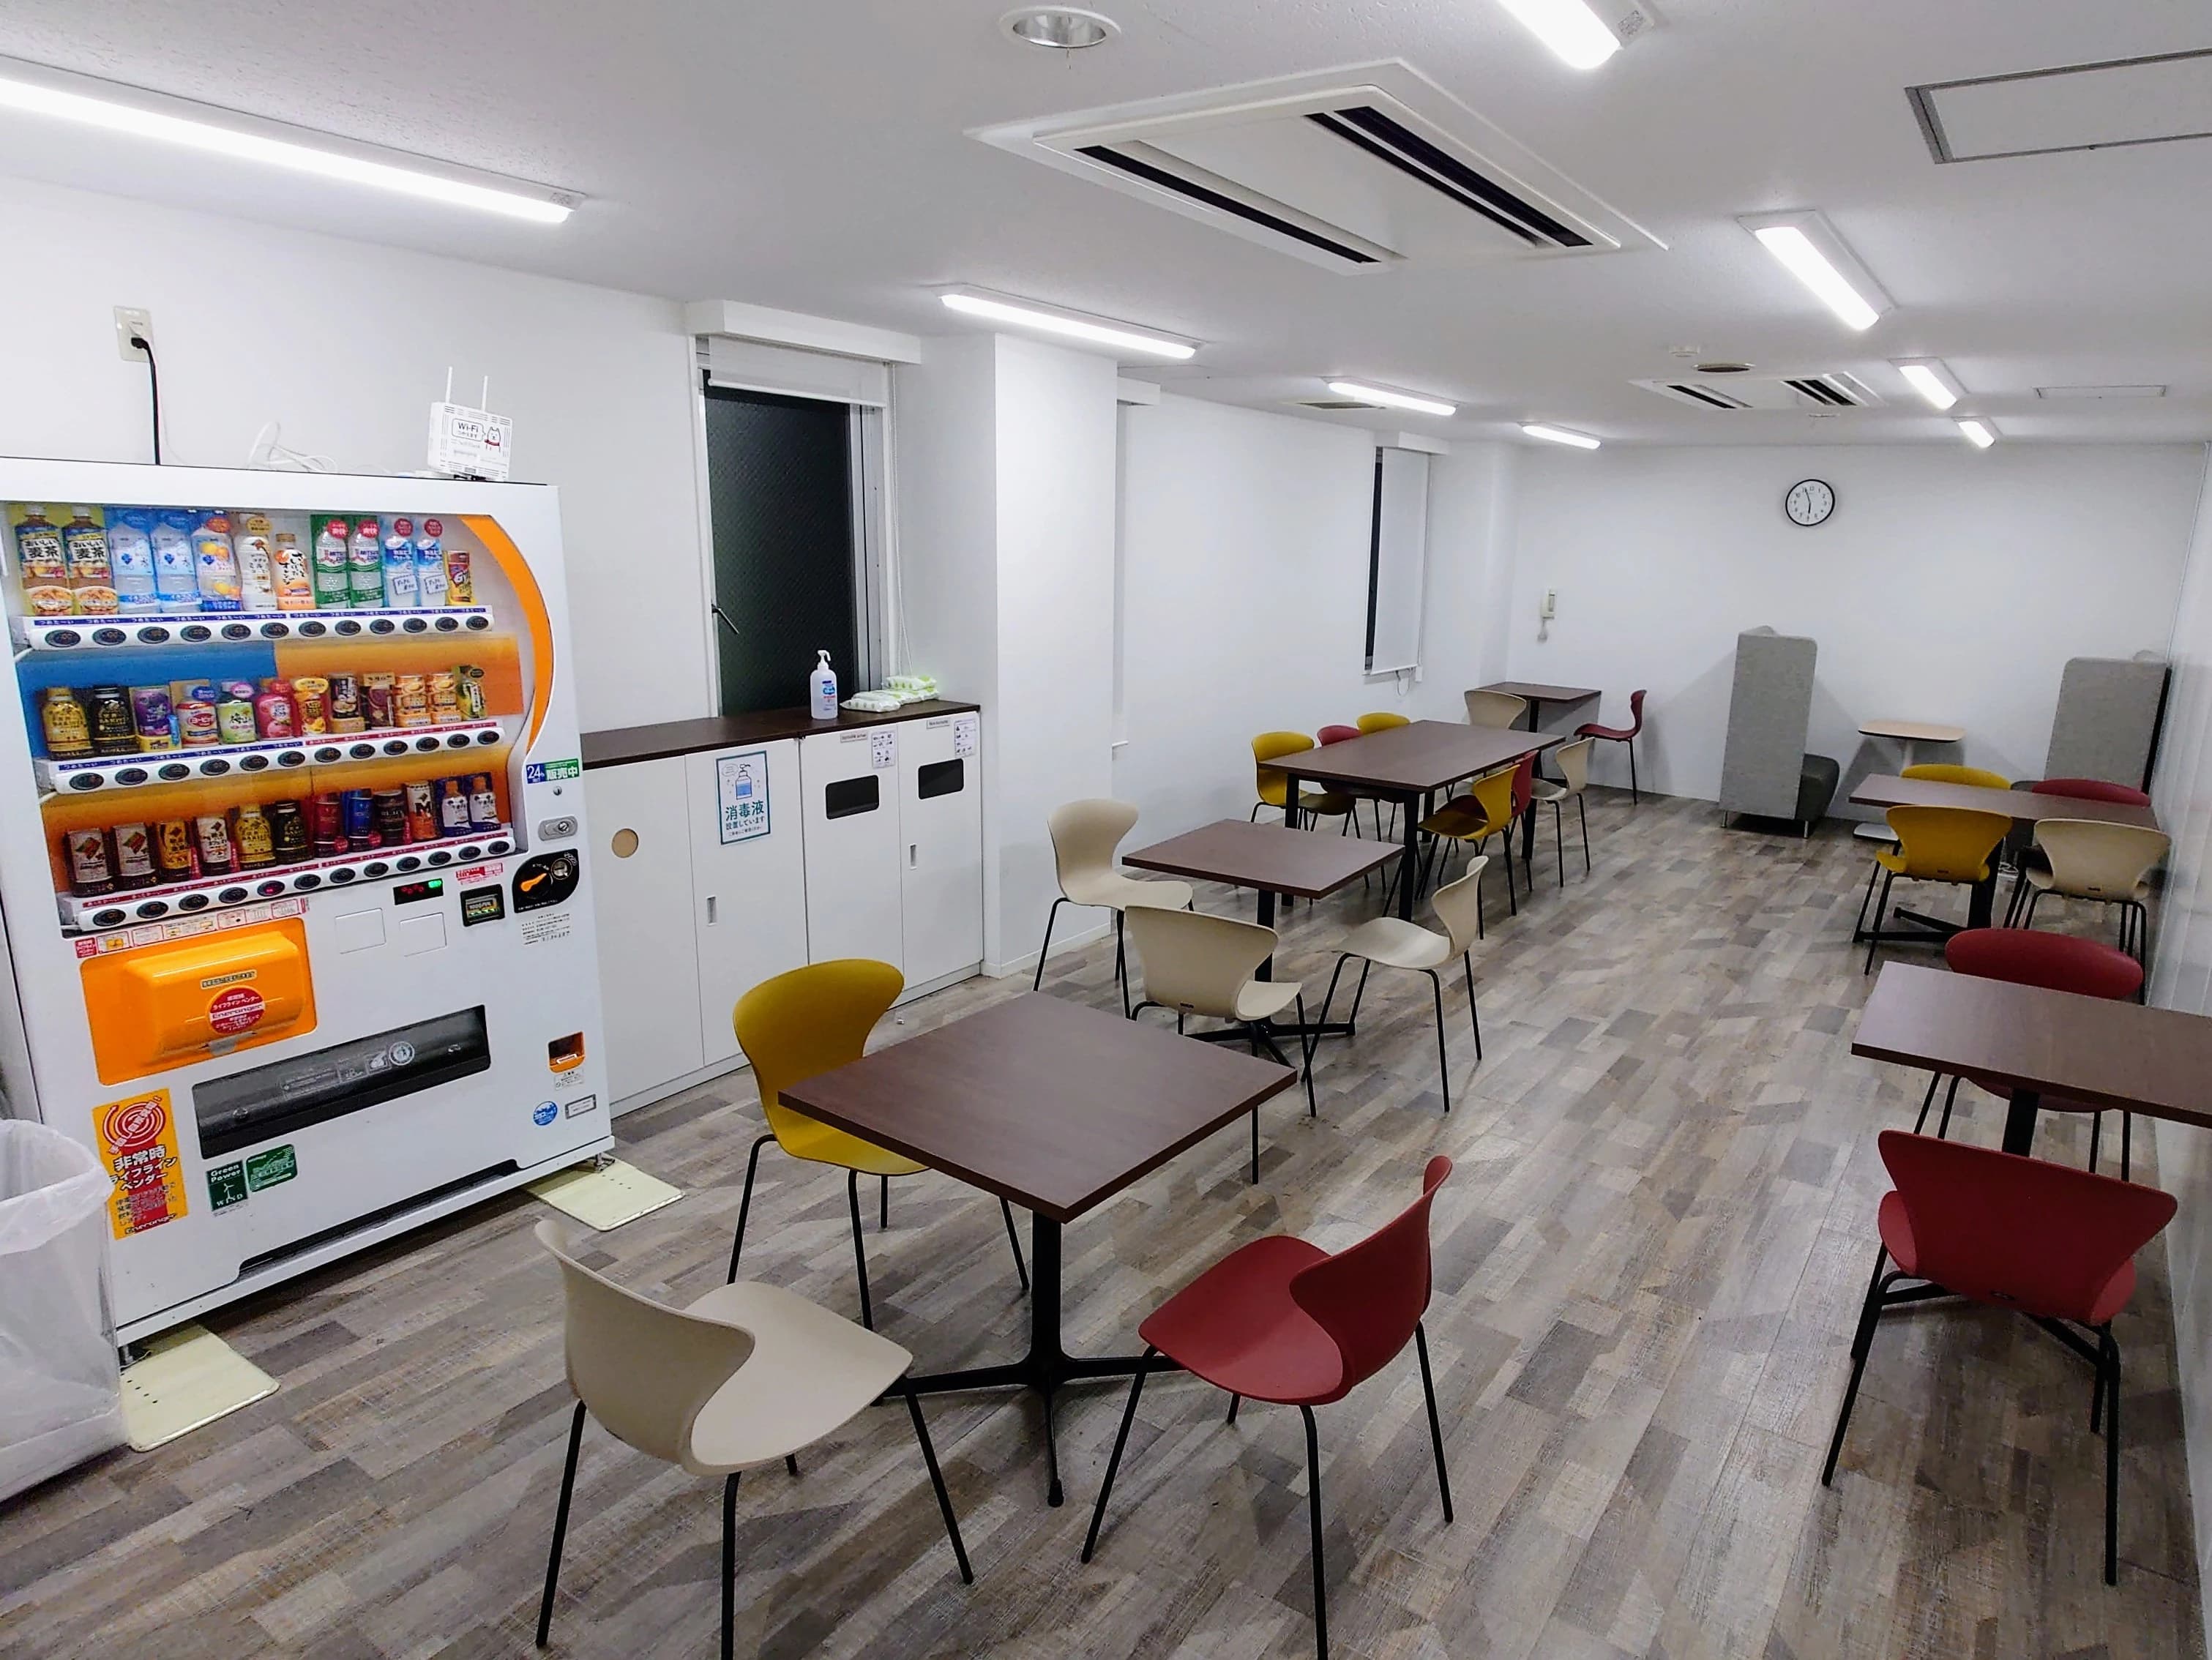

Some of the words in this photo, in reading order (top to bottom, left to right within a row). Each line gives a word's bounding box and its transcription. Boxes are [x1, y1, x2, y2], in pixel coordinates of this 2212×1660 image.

[458, 422, 478, 433] Wi-Fi
[29, 546, 59, 558] 麦茶
[75, 547, 105, 559] 麦茶
[547, 766, 578, 780] 販売中
[725, 800, 764, 821] 消毒液
[725, 816, 765, 831] 設置しています
[114, 1144, 165, 1171] 非常時
[110, 1157, 176, 1184] ライフライン
[211, 1164, 239, 1177] Green
[211, 1170, 241, 1183] Power
[121, 1173, 168, 1191] ベンダー
